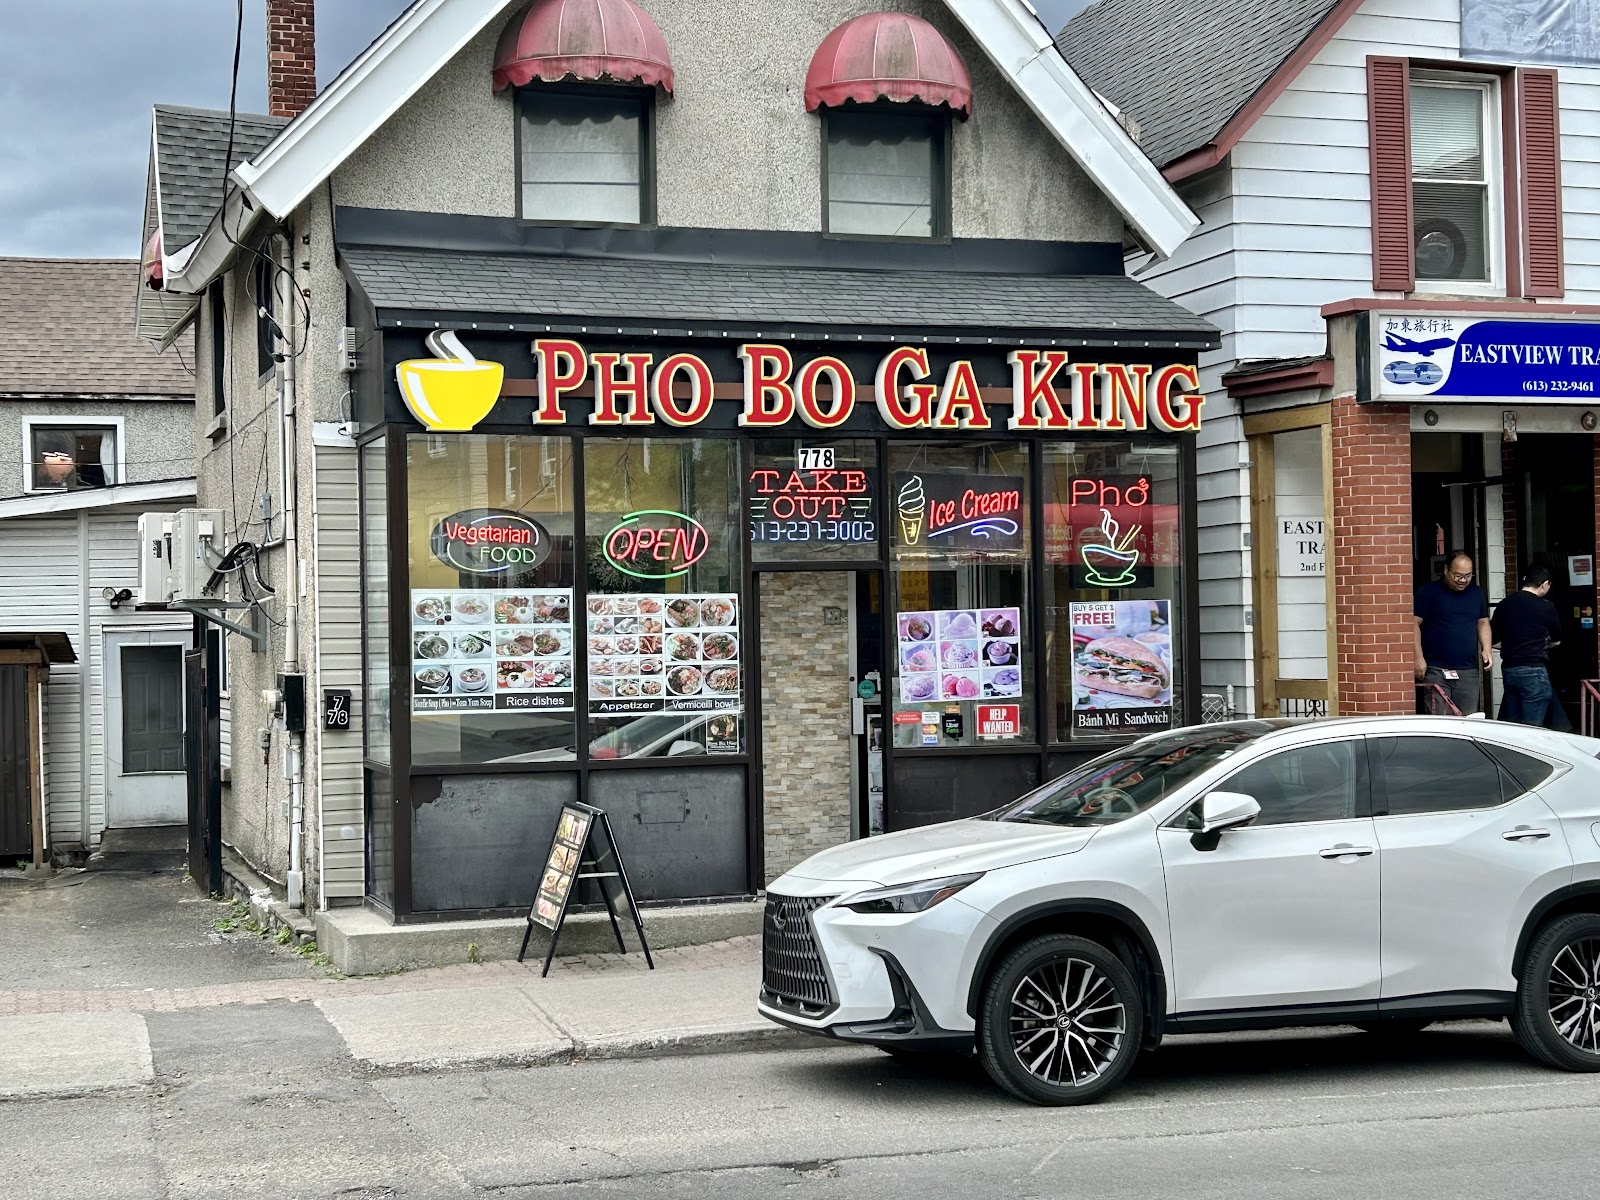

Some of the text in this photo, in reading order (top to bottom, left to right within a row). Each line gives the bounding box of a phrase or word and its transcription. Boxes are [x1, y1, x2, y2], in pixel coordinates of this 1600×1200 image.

[1386, 317, 1454, 333] 加東旅行社
[1460, 343, 1563, 365] EASTVIEW
[1522, 381, 1594, 392] (613) 232-9461
[800, 449, 833, 469] 778
[749, 470, 867, 493] TAKE
[772, 495, 846, 519] OUT
[929, 489, 1019, 529] Ice Cream
[445, 521, 531, 546] Vegetarian
[609, 527, 700, 561] OPEN
[480, 546, 536, 564] FOOD
[1300, 562, 1317, 572] 2nd
[1073, 604, 1086, 612] BUY
[1073, 612, 1115, 625] FREE!
[506, 695, 565, 707] Rice dishes
[599, 700, 734, 711] Appetizer Vermicelli bowl
[989, 708, 1008, 721] HELP
[1078, 714, 1103, 727] Bánh
[1124, 711, 1169, 725] Sandwich
[983, 721, 1014, 734] WANTED
